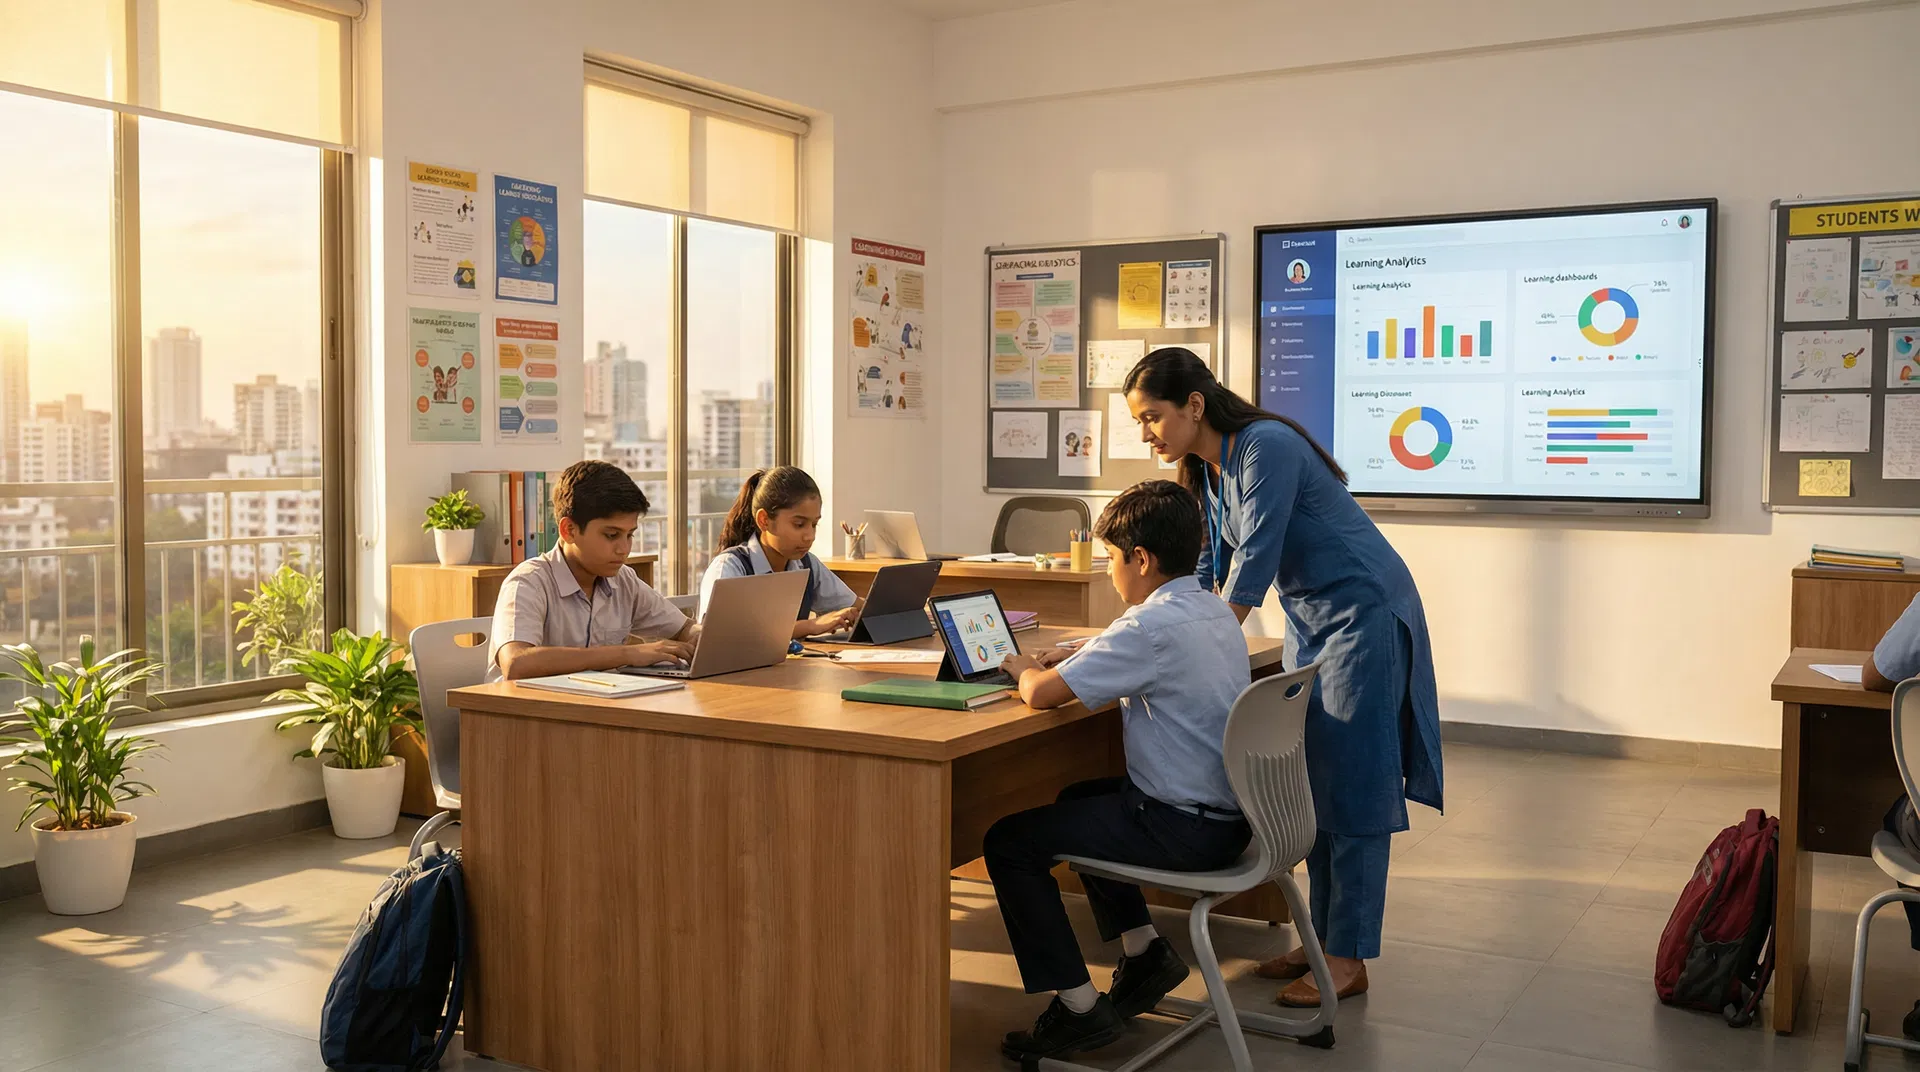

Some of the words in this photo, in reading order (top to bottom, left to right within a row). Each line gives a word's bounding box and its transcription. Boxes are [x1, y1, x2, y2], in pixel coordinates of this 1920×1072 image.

[1816, 209, 1899, 228] STUDENTS
[1345, 258, 1384, 269] Learning
[1385, 256, 1427, 268] Analytics
[1523, 275, 1555, 283] Learning
[1555, 272, 1598, 282] dashboards
[1352, 282, 1381, 291] Learning
[1381, 281, 1411, 290] Analytics
[1351, 391, 1379, 399] Learning
[1521, 389, 1552, 397] Learning
[1552, 388, 1586, 397] Analytics
